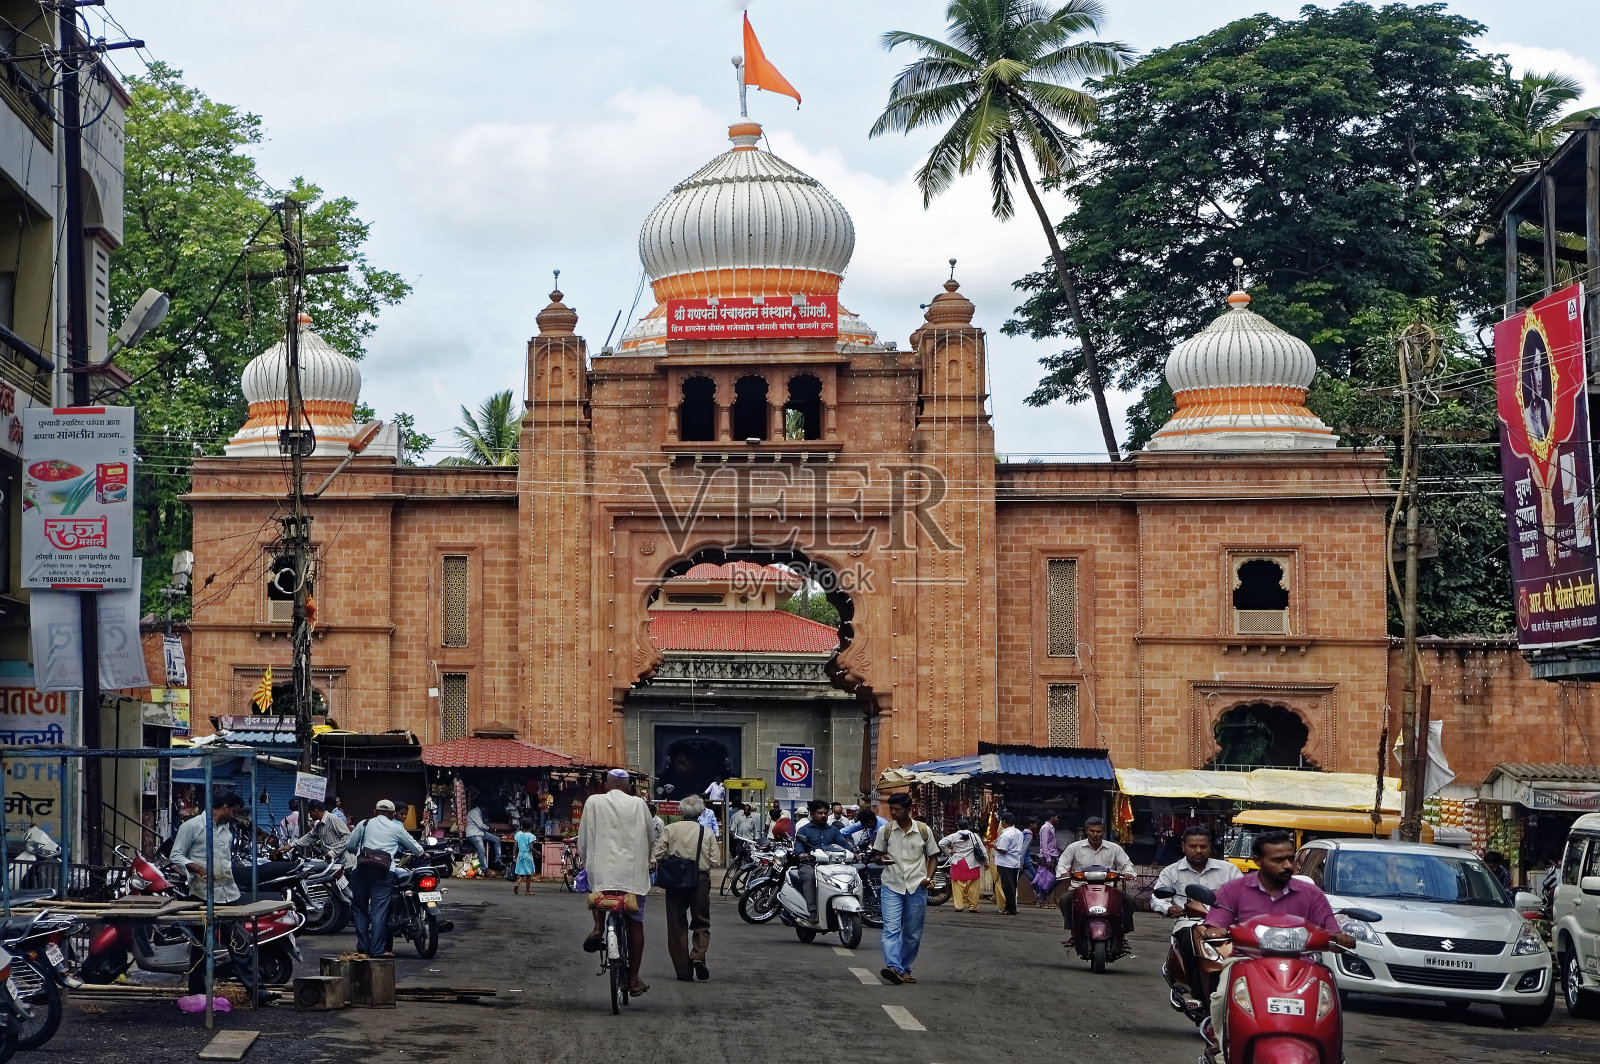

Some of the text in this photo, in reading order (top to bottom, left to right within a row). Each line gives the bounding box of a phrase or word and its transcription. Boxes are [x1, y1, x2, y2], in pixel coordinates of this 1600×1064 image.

[674, 305, 685, 321] श्री
[687, 305, 718, 320] गणपती
[719, 303, 759, 320] पंचायतन
[760, 303, 796, 321] संस्थान,
[56, 428, 95, 439] सांगलीत
[79, 537, 105, 546] मसाले
